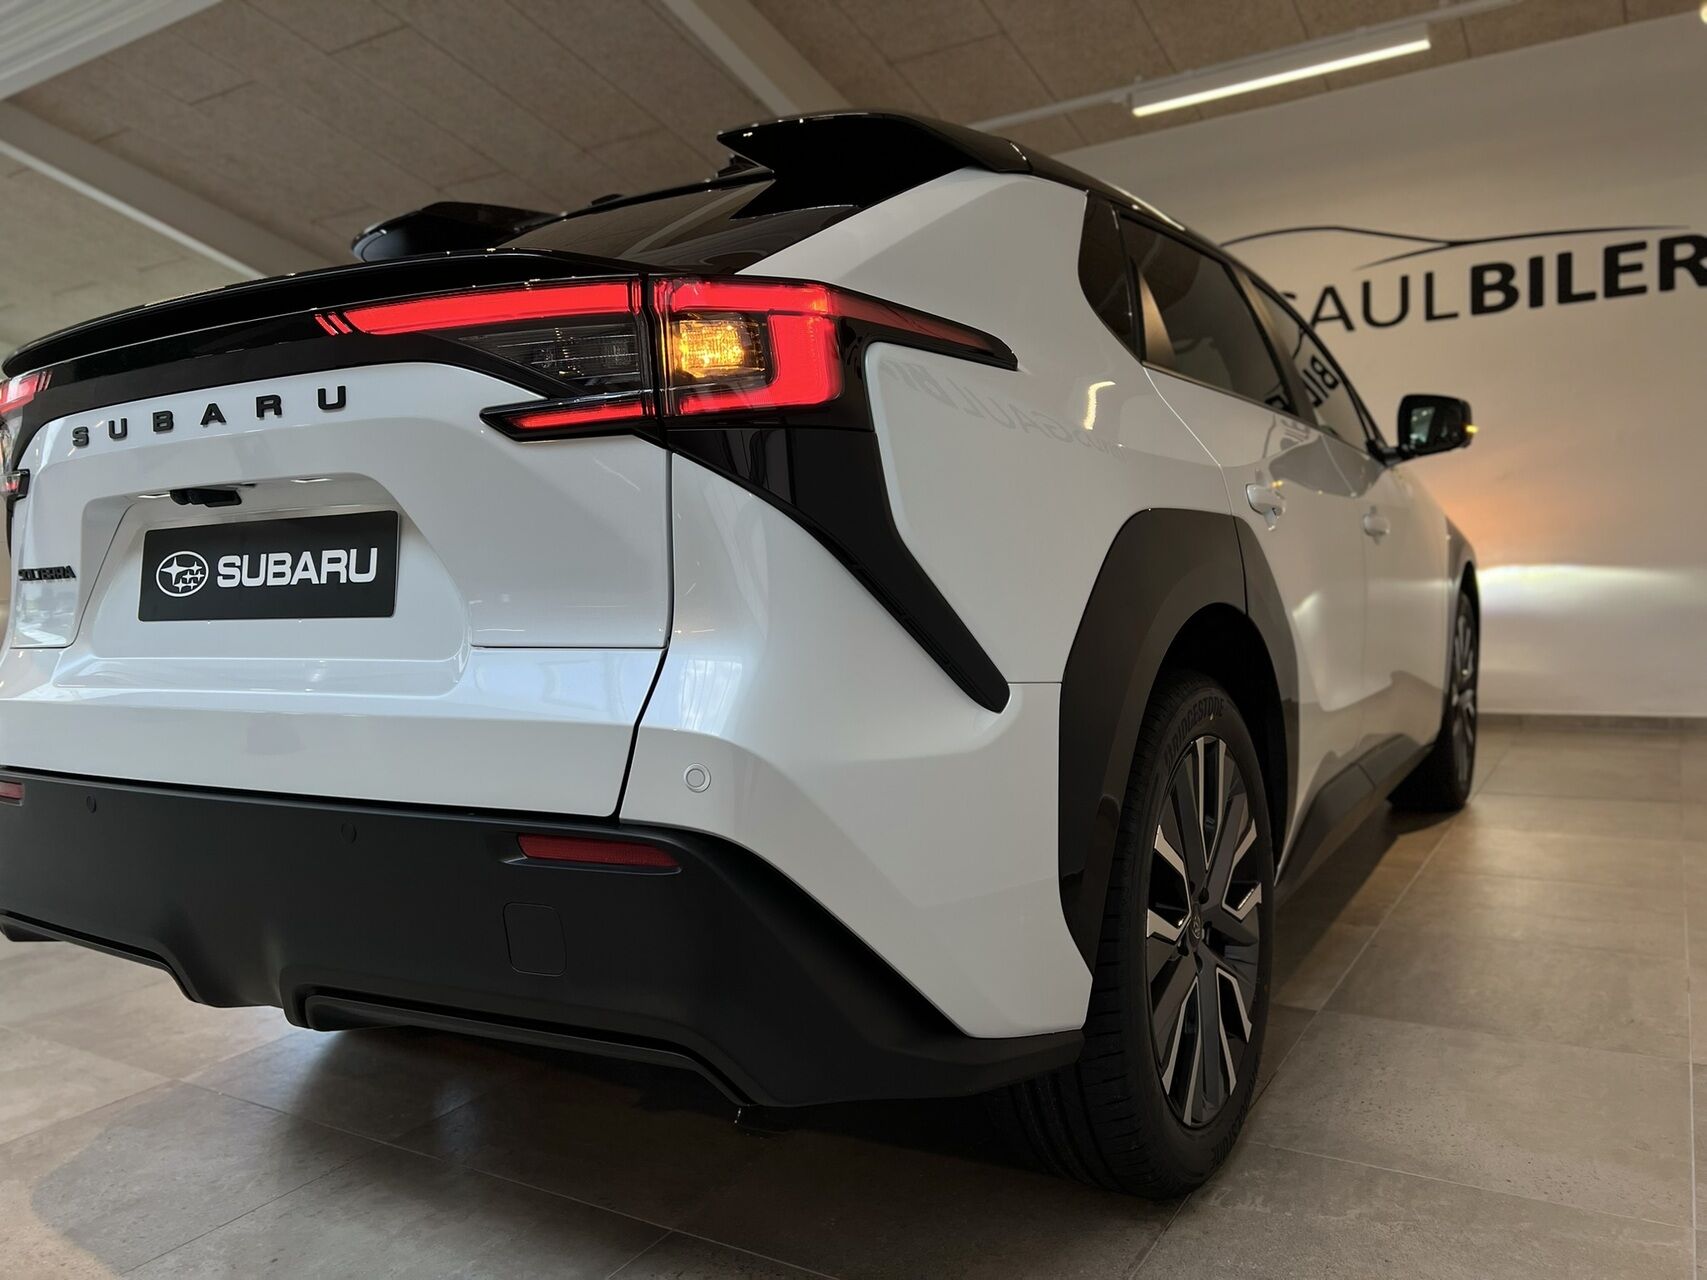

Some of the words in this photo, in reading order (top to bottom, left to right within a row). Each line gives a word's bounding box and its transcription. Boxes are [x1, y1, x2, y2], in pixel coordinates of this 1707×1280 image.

[1281, 234, 1707, 332] AULBILER
[72, 385, 347, 447] SUBARU
[217, 548, 378, 588] SUBARU
[1163, 695, 1225, 769] BRIDGESTONE
